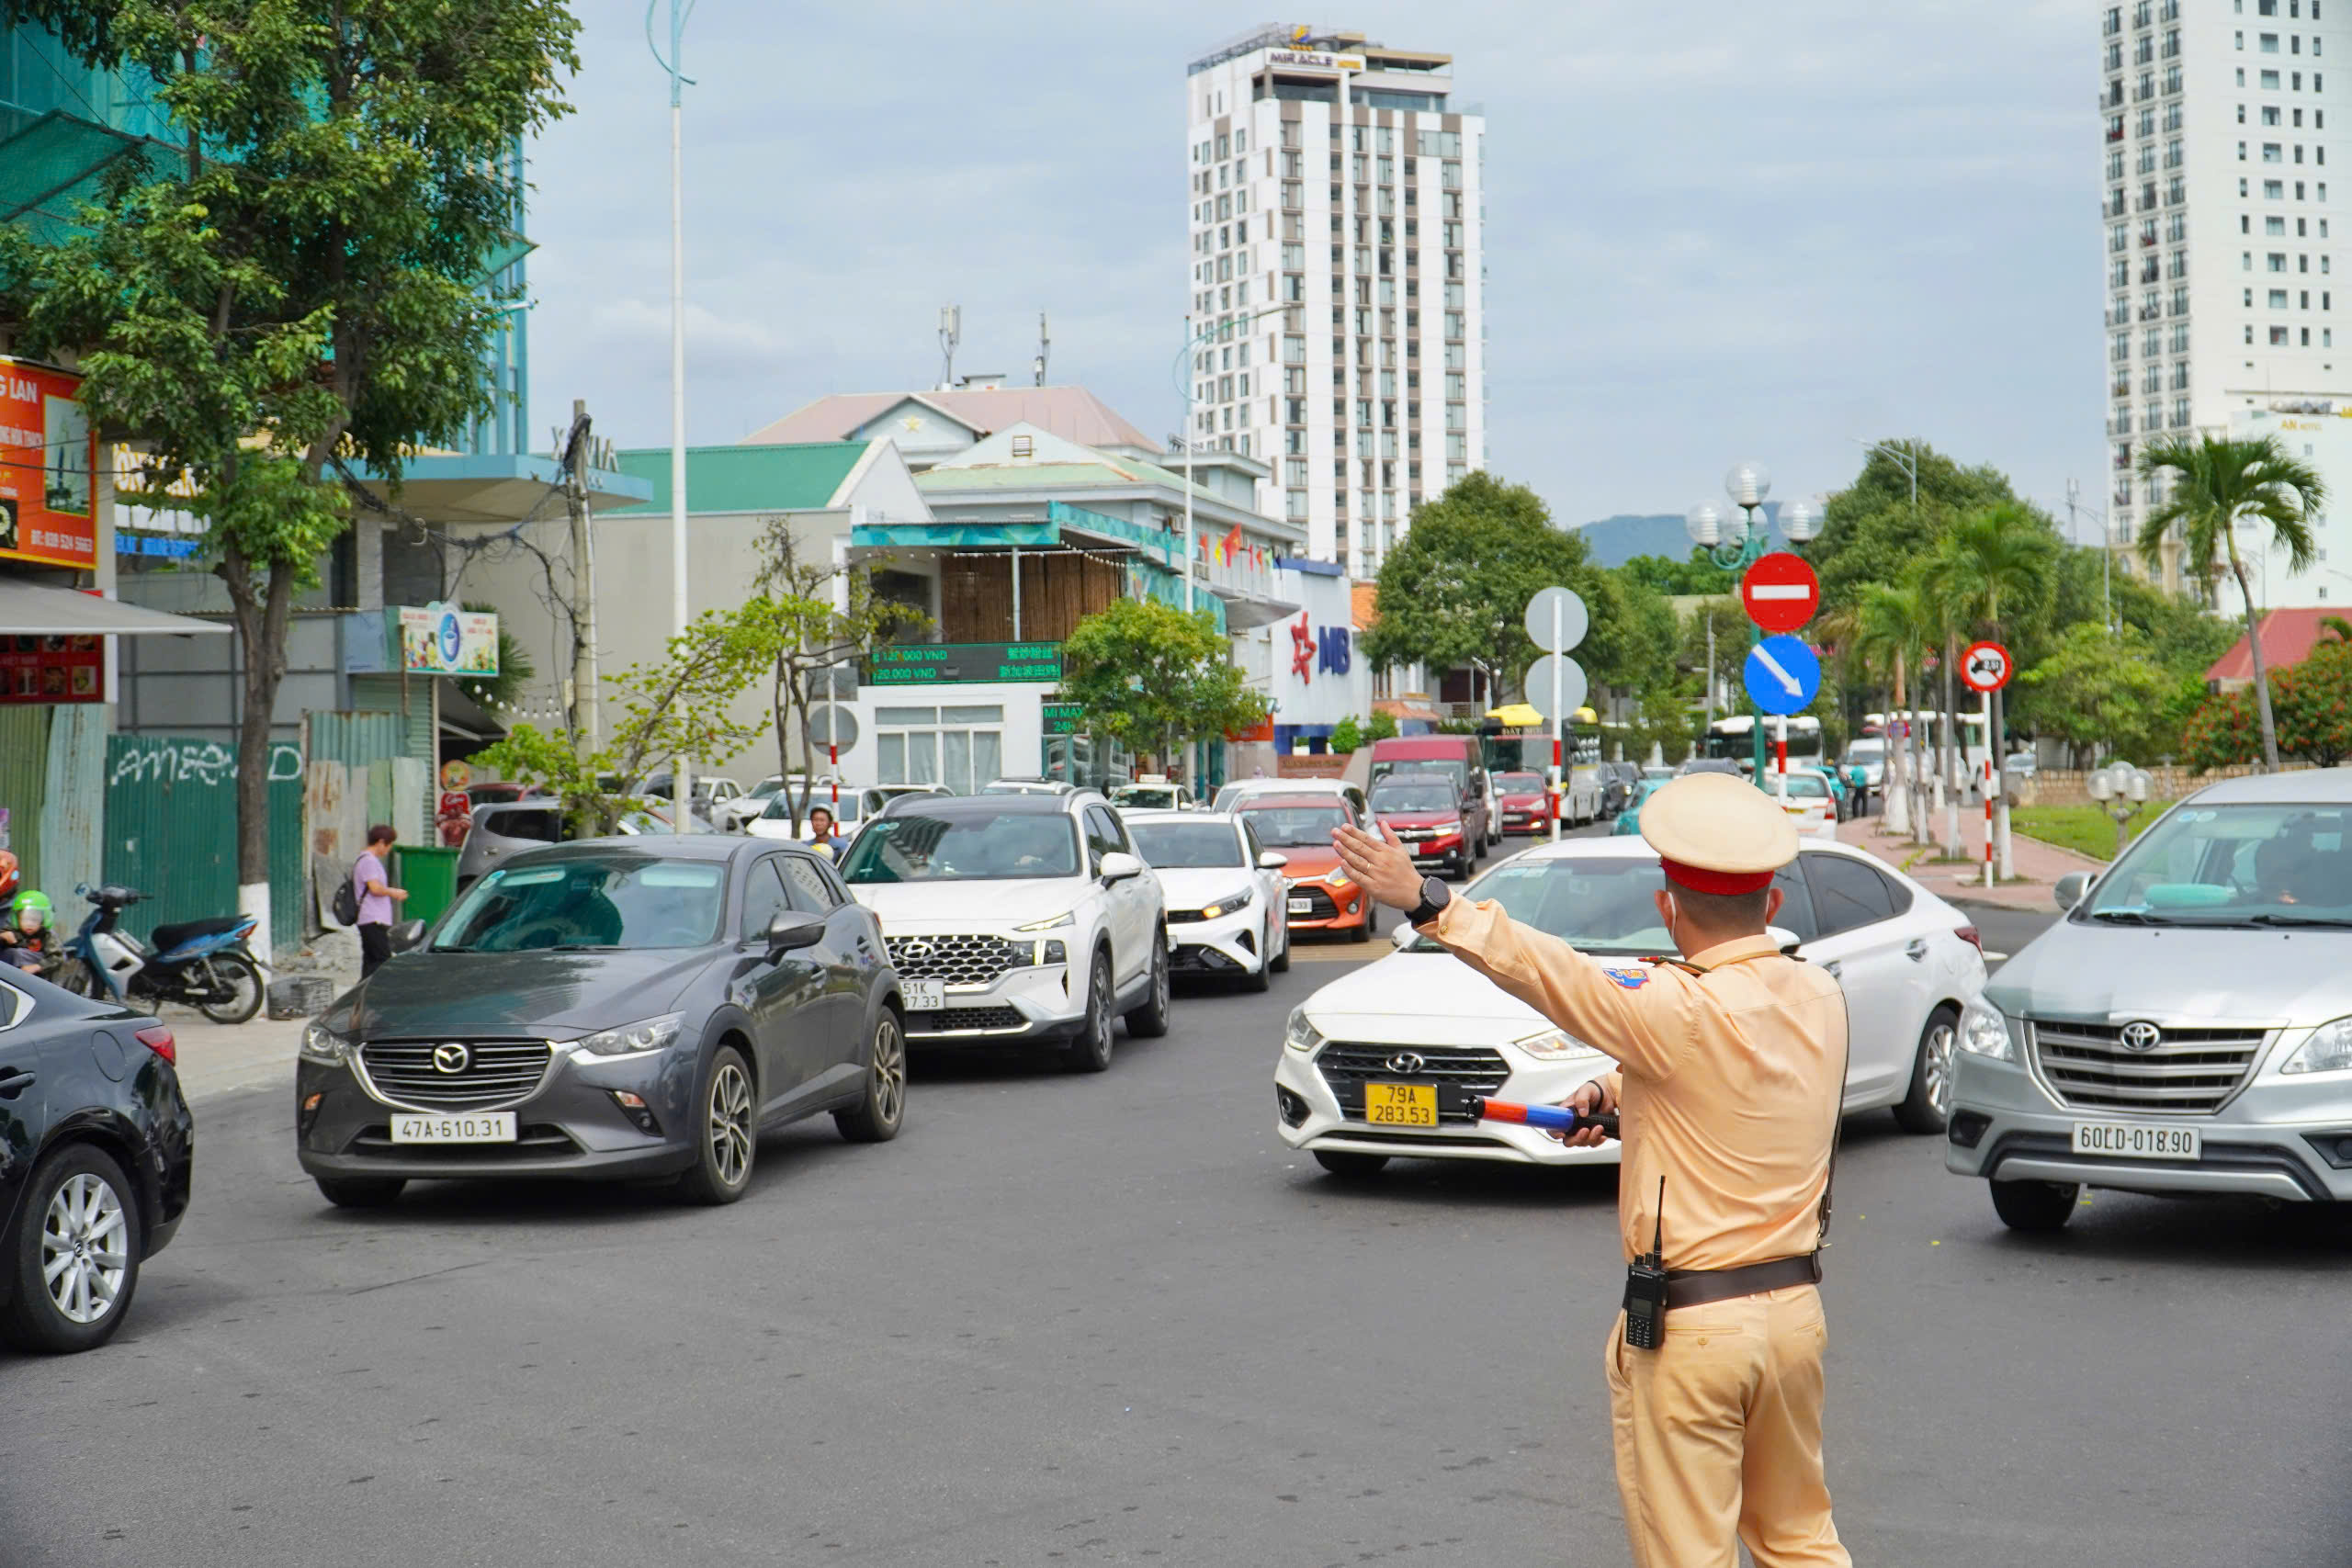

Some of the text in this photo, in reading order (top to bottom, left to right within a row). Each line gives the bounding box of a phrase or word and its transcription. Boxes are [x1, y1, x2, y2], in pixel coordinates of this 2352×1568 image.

[1271, 52, 1332, 66] MIRACLE
[10, 377, 37, 404] LAN
[923, 649, 947, 660] VND
[1318, 626, 1351, 675] MB
[912, 668, 936, 679] VND
[903, 982, 927, 995] 51K
[1387, 1086, 1416, 1103] 79A
[1374, 1106, 1430, 1123] 283.53
[401, 1120, 503, 1138] 47A-610.31
[2081, 1126, 2192, 1154] 60LD-018.90
